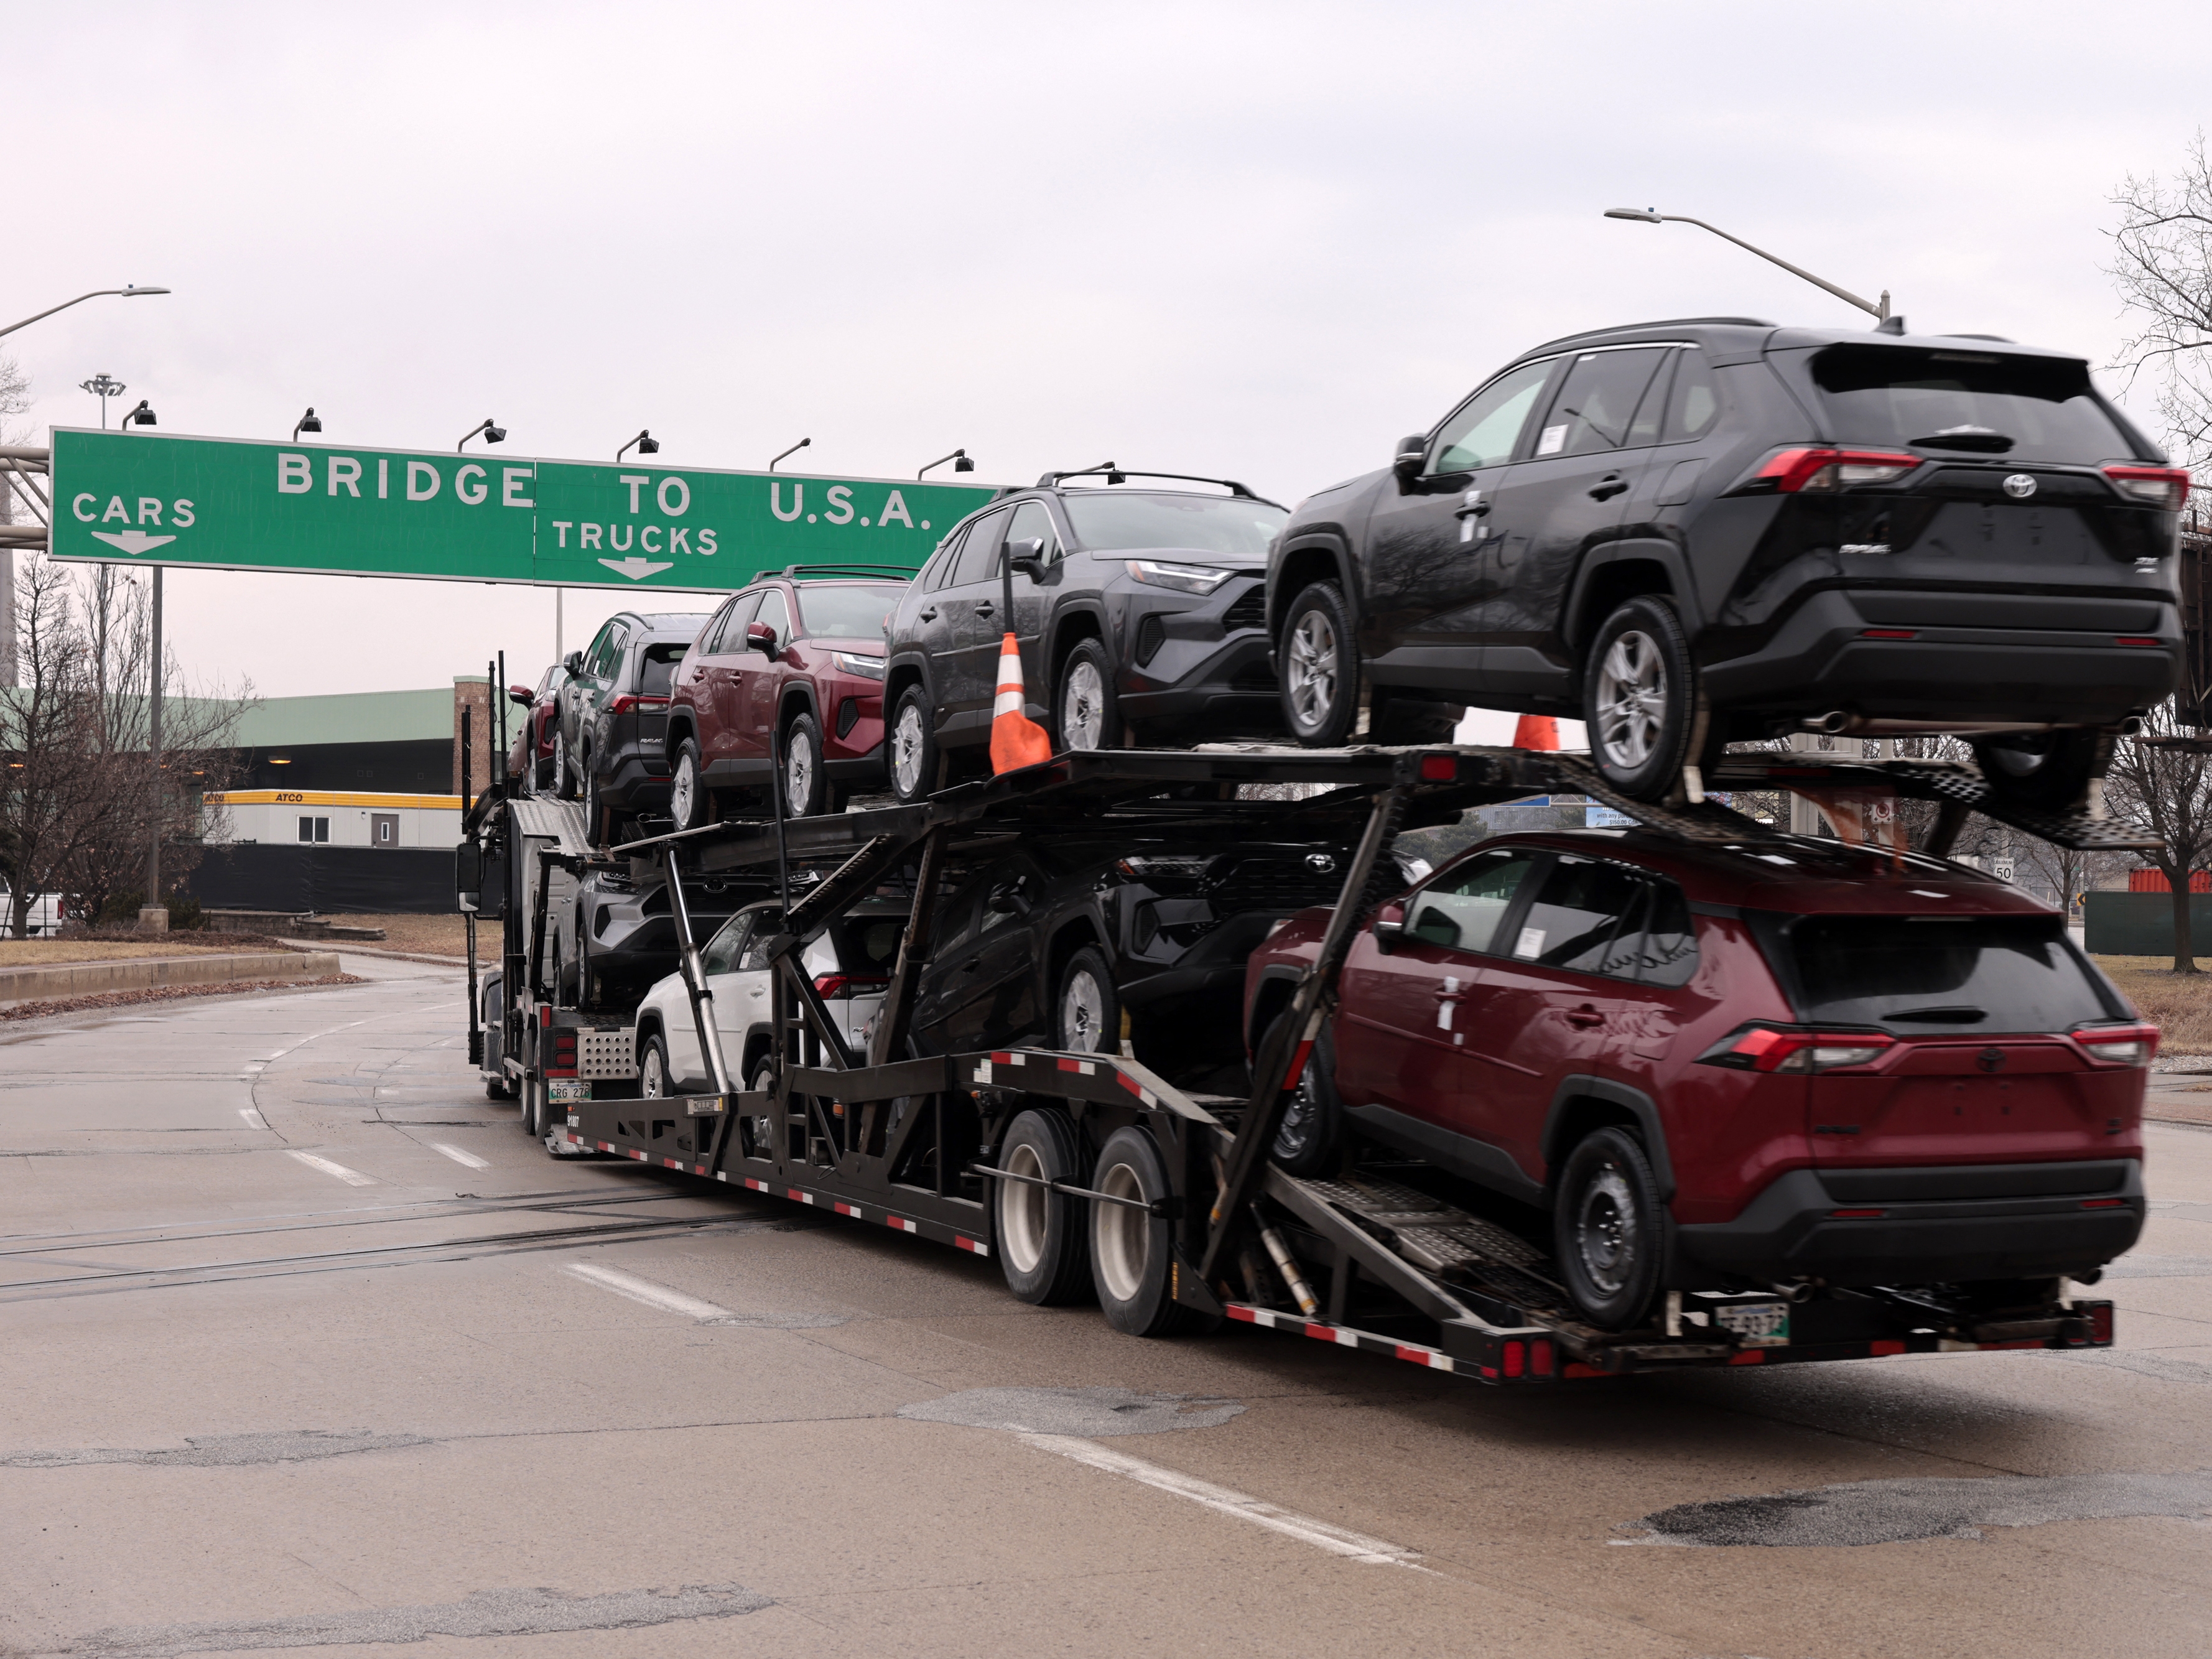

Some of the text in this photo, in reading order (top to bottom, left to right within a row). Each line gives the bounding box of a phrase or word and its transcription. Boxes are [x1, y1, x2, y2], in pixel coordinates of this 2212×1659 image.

[278, 453, 931, 530] BRIDGE TO U.S.A.
[73, 493, 195, 527] CARS
[552, 521, 718, 555] TRUCKS
[276, 793, 303, 802] ATCO
[1997, 868, 2011, 879] 50
[551, 1087, 590, 1098] CRG 278
